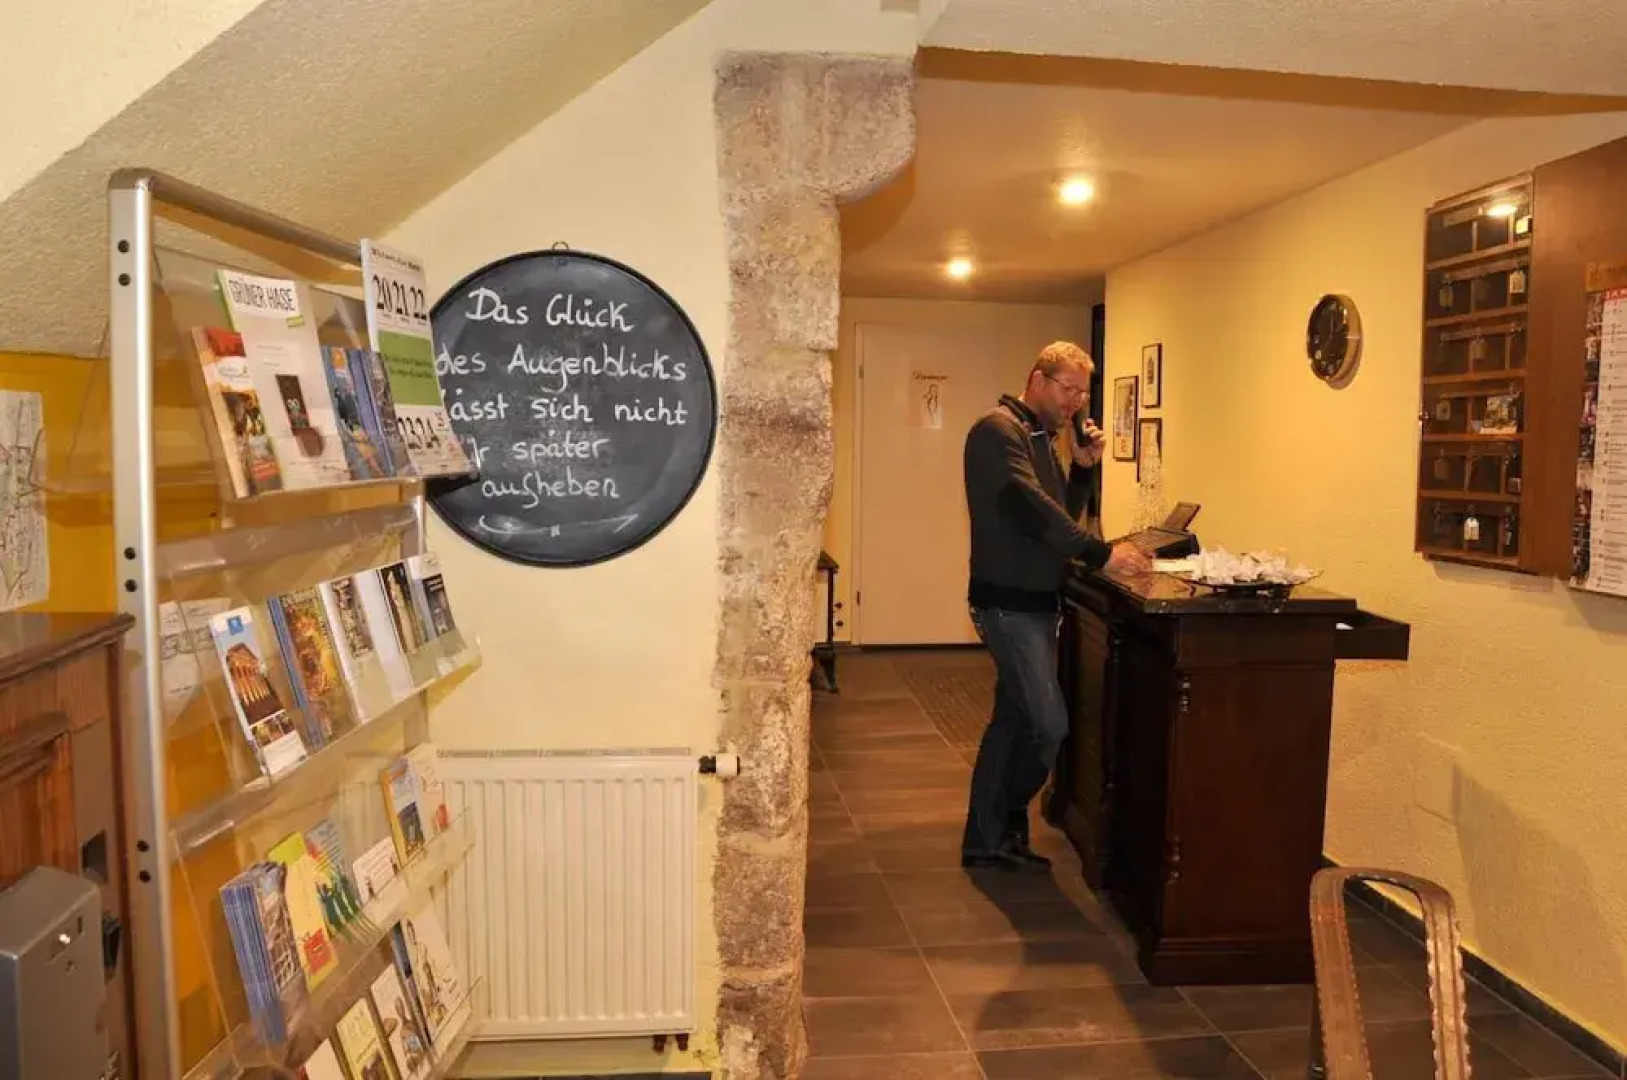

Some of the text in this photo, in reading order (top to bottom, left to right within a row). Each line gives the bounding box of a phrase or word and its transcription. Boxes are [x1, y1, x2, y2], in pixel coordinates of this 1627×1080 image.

[266, 286, 296, 312] HASE
[372, 274, 393, 313] 20
[410, 285, 427, 320] 22
[465, 287, 634, 332] Das Glück
[436, 343, 486, 376] des
[507, 342, 687, 393] Augenblicks
[531, 393, 594, 422] sich
[614, 395, 688, 426] nicht
[511, 429, 611, 465] später
[481, 467, 621, 509] aufheben
